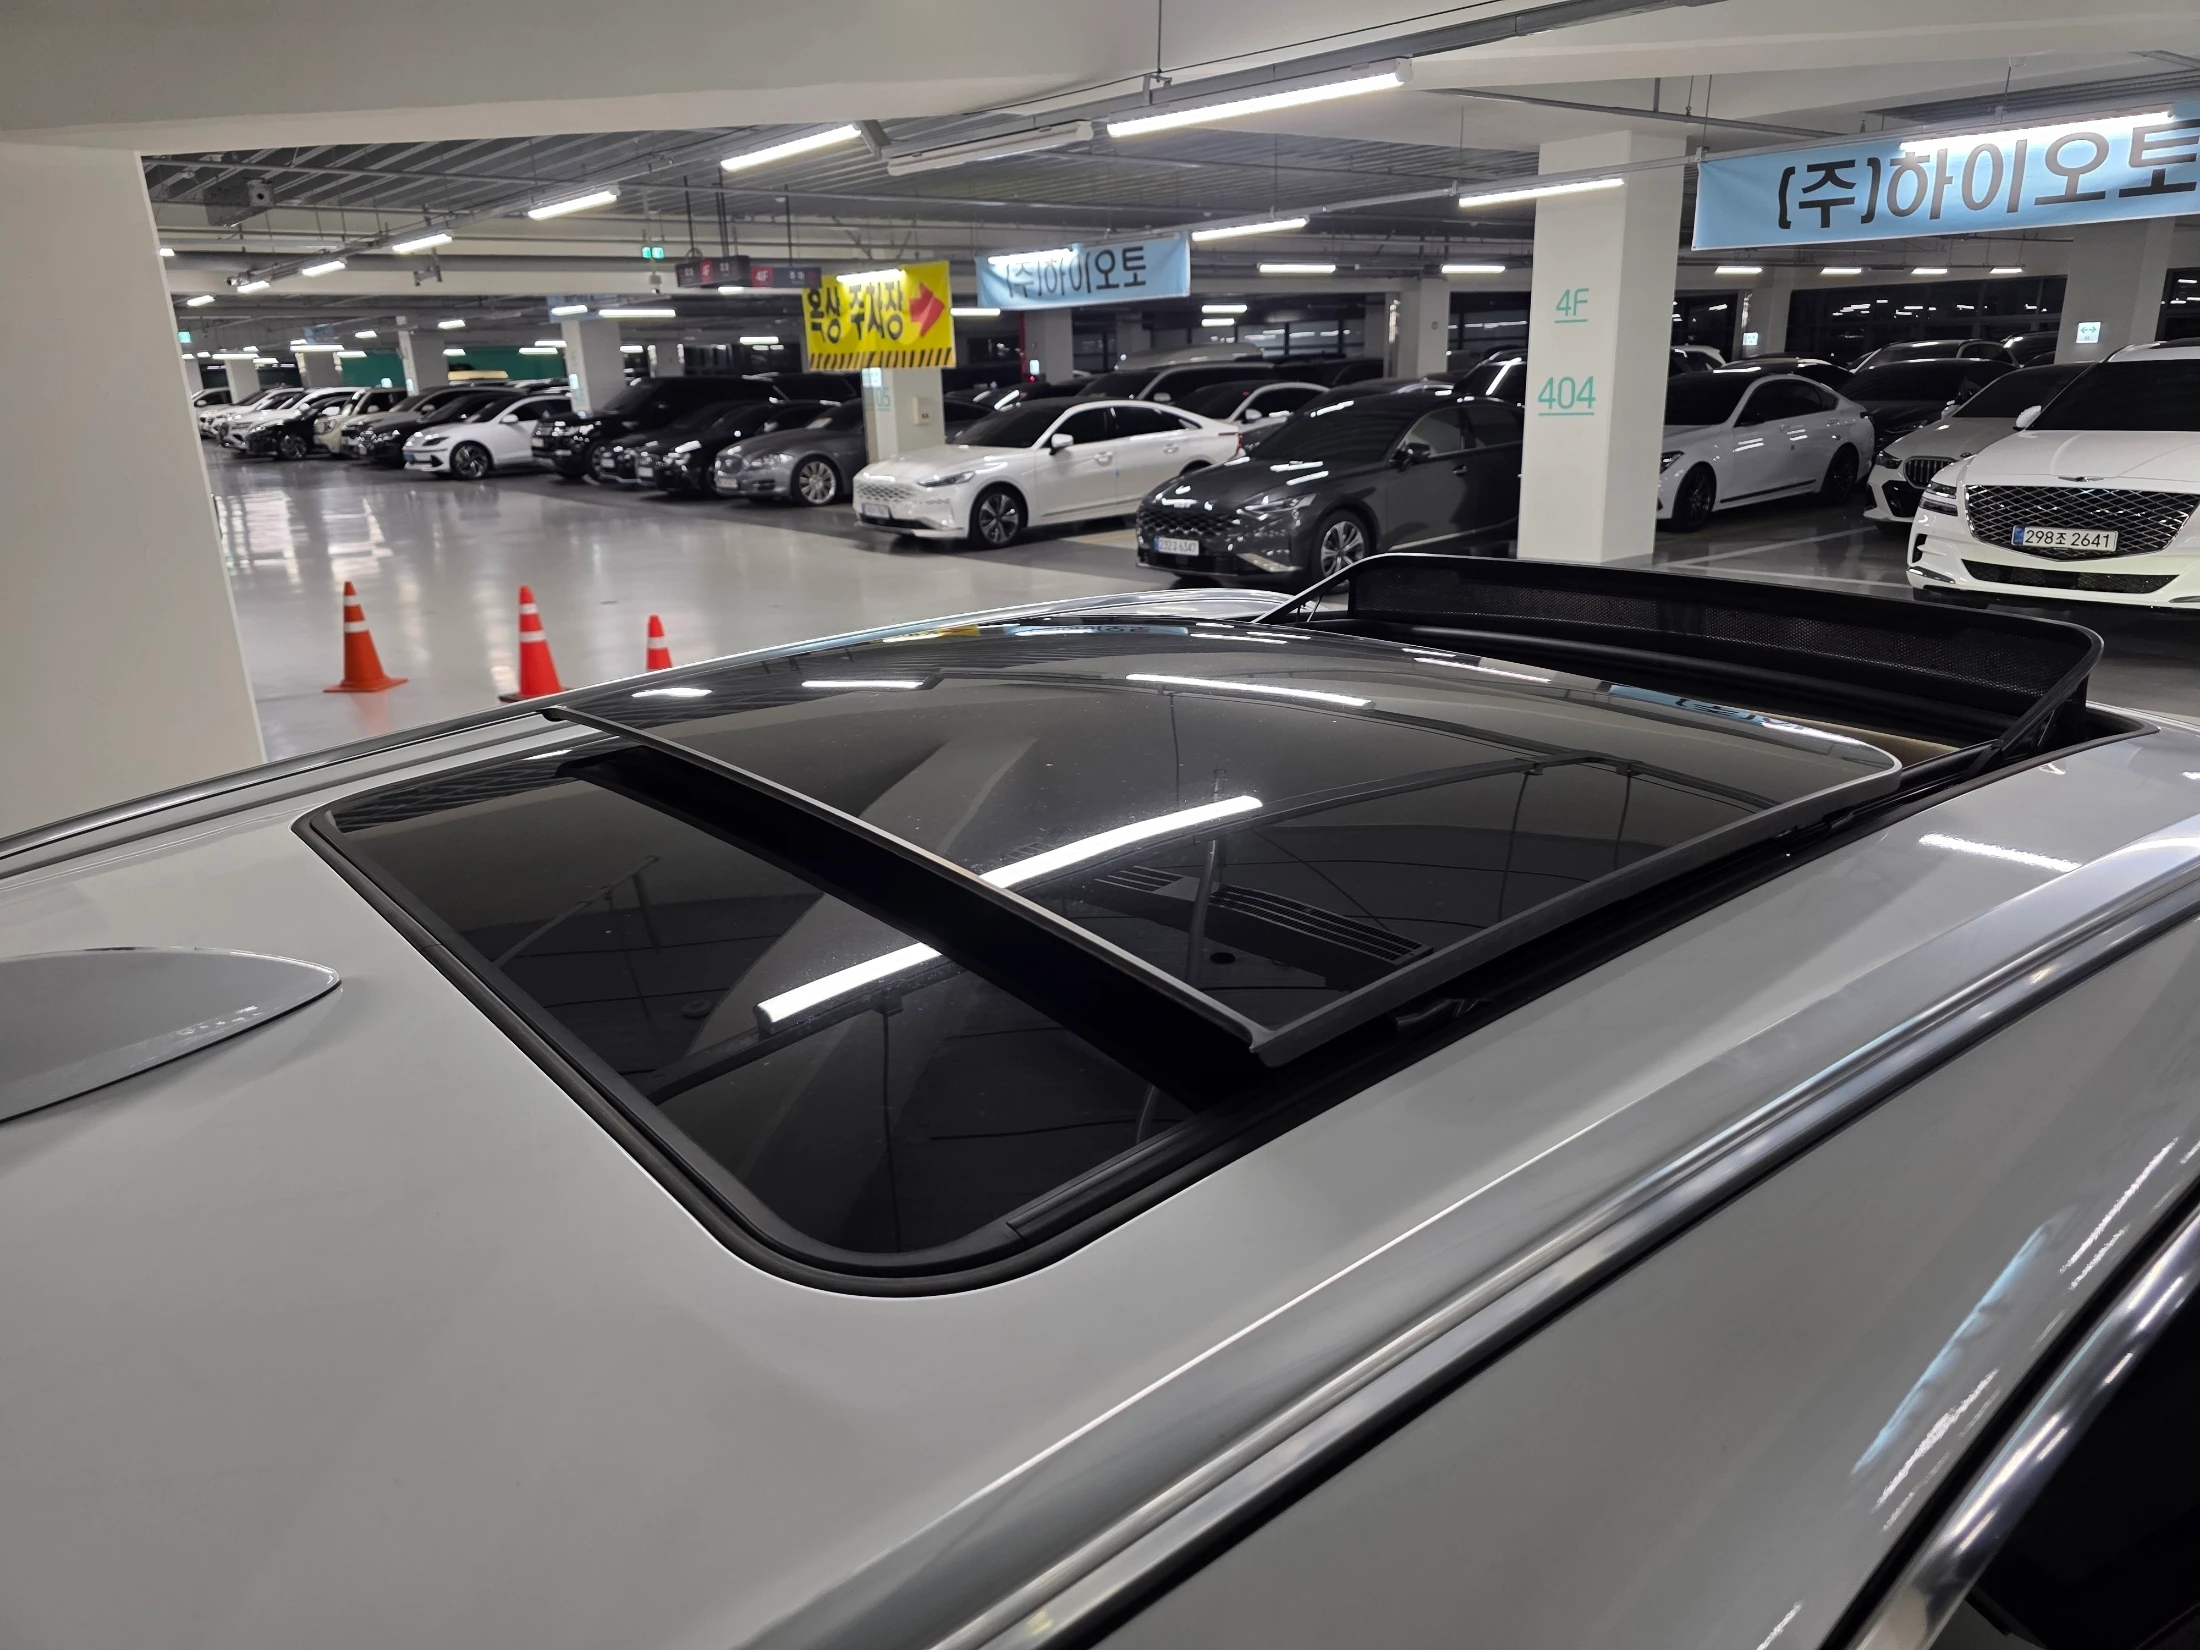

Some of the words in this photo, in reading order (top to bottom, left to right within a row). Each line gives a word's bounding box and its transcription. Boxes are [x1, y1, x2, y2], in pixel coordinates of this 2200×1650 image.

[1777, 120, 2200, 230] (주)하이오토
[807, 286, 841, 344] 옥상
[850, 280, 904, 341] 주차장
[1555, 287, 1590, 317] 4F
[1536, 375, 1596, 410] 404
[2024, 529, 2067, 545] 298조
[2070, 532, 2110, 548] 2641
